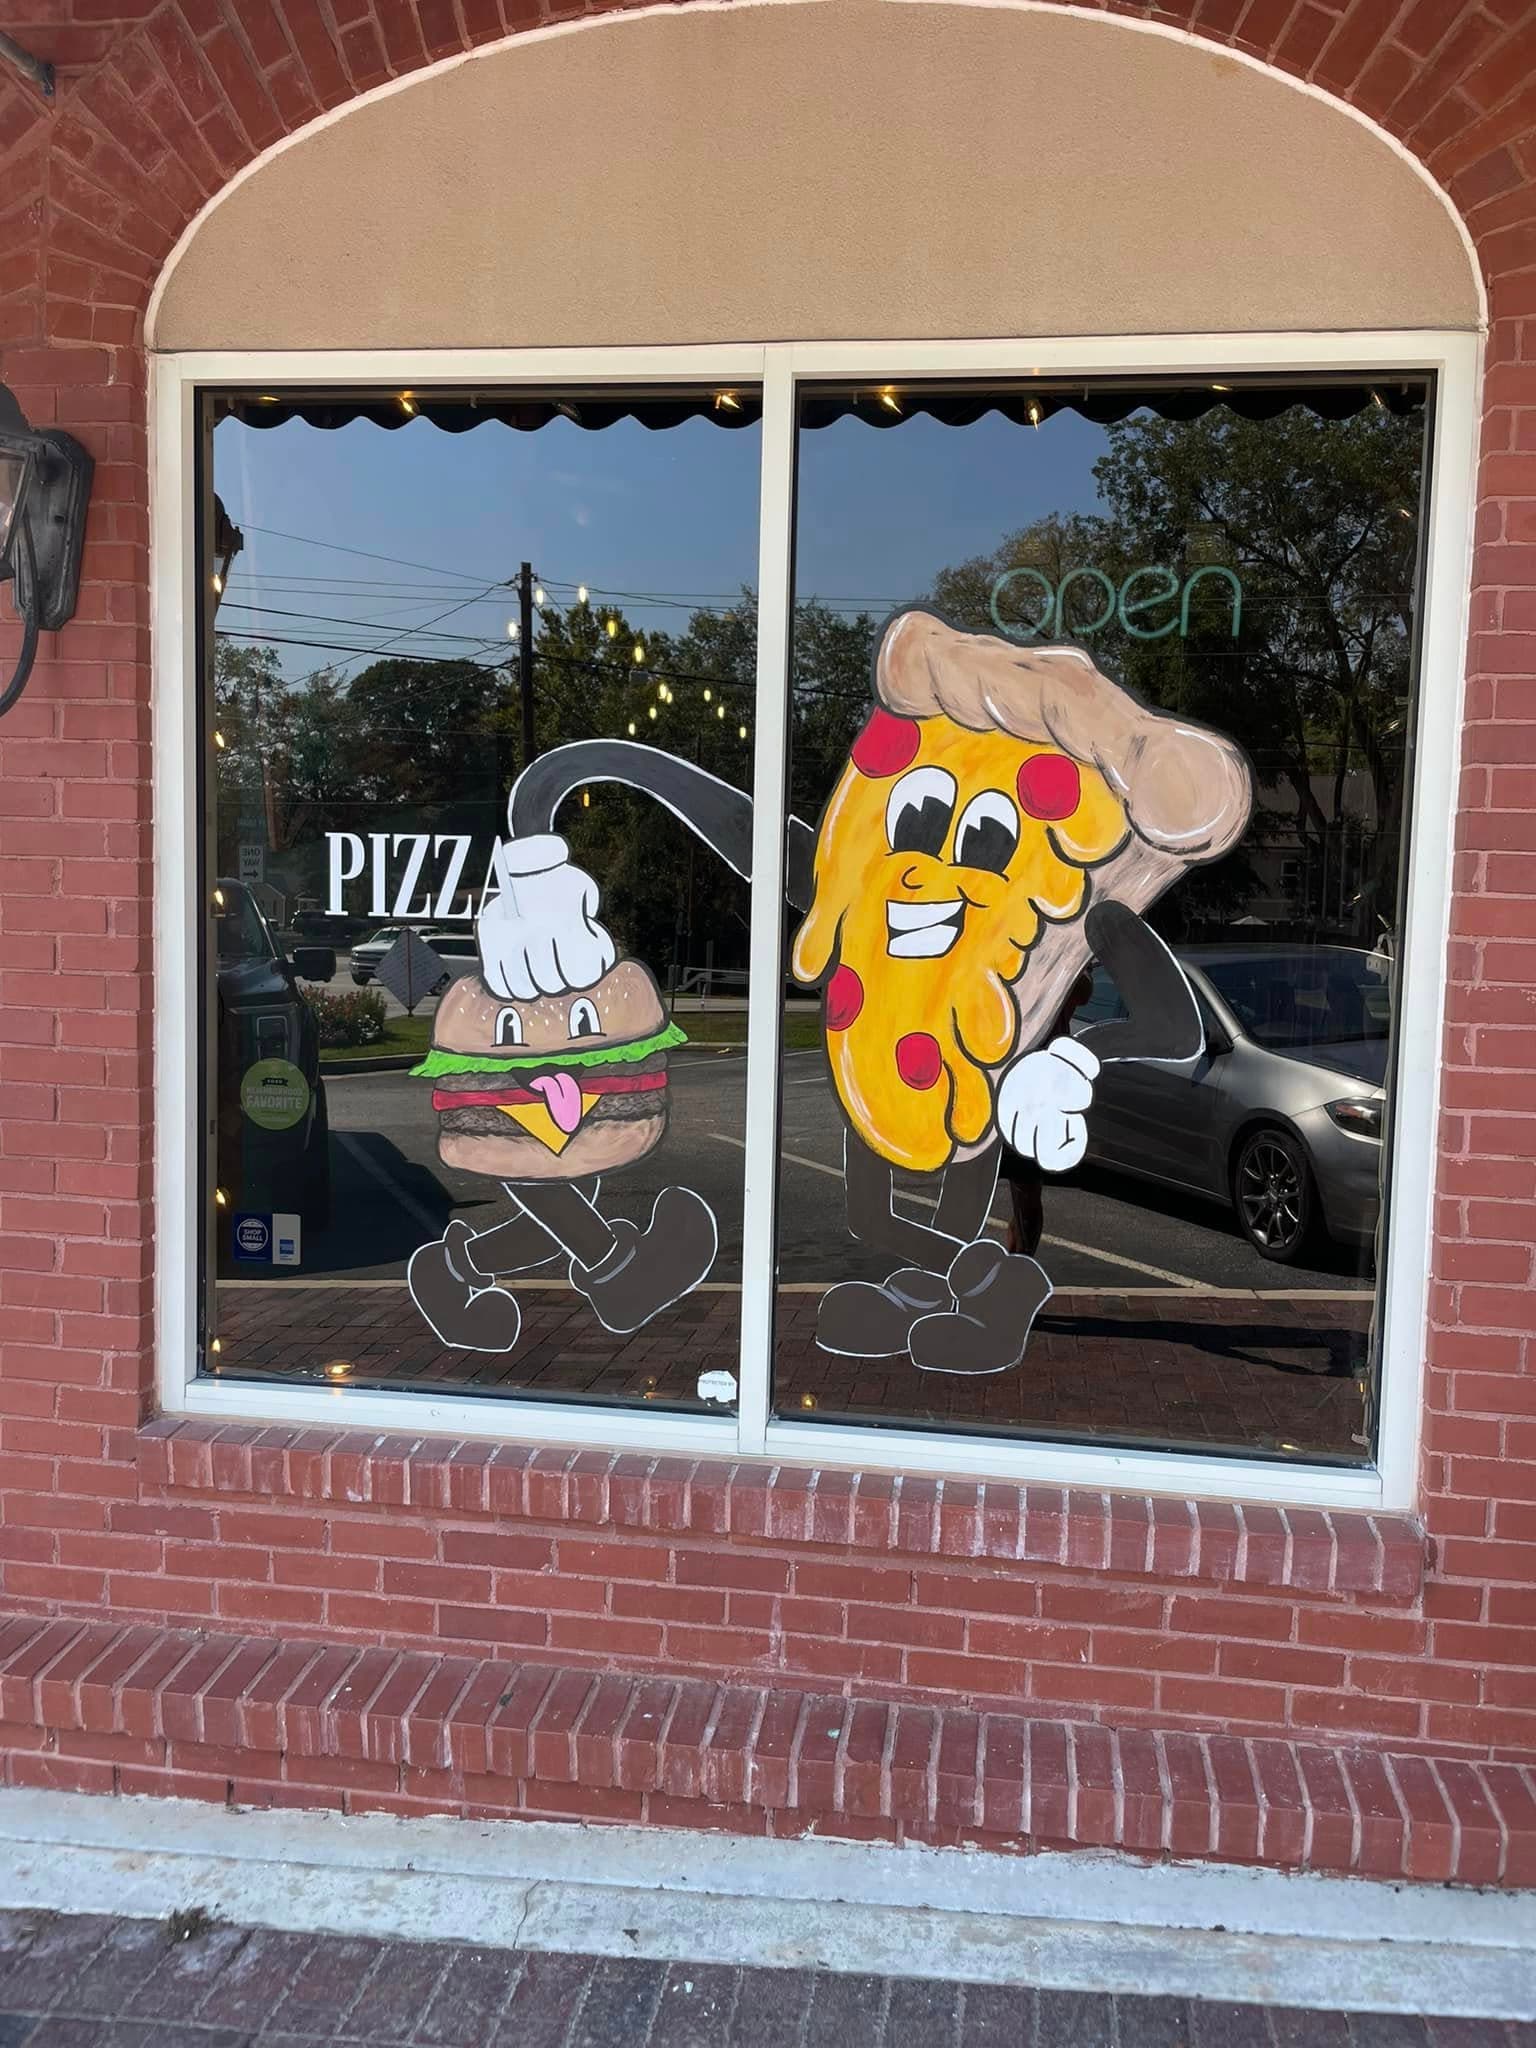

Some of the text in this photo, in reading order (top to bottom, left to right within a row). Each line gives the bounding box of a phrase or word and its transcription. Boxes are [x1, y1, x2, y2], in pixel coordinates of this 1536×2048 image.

[324, 831, 521, 920] PIZZA
[246, 1096, 303, 1109] FAVORITE
[242, 1233, 264, 1242] SMALL
[243, 1228, 262, 1236] SHOP
